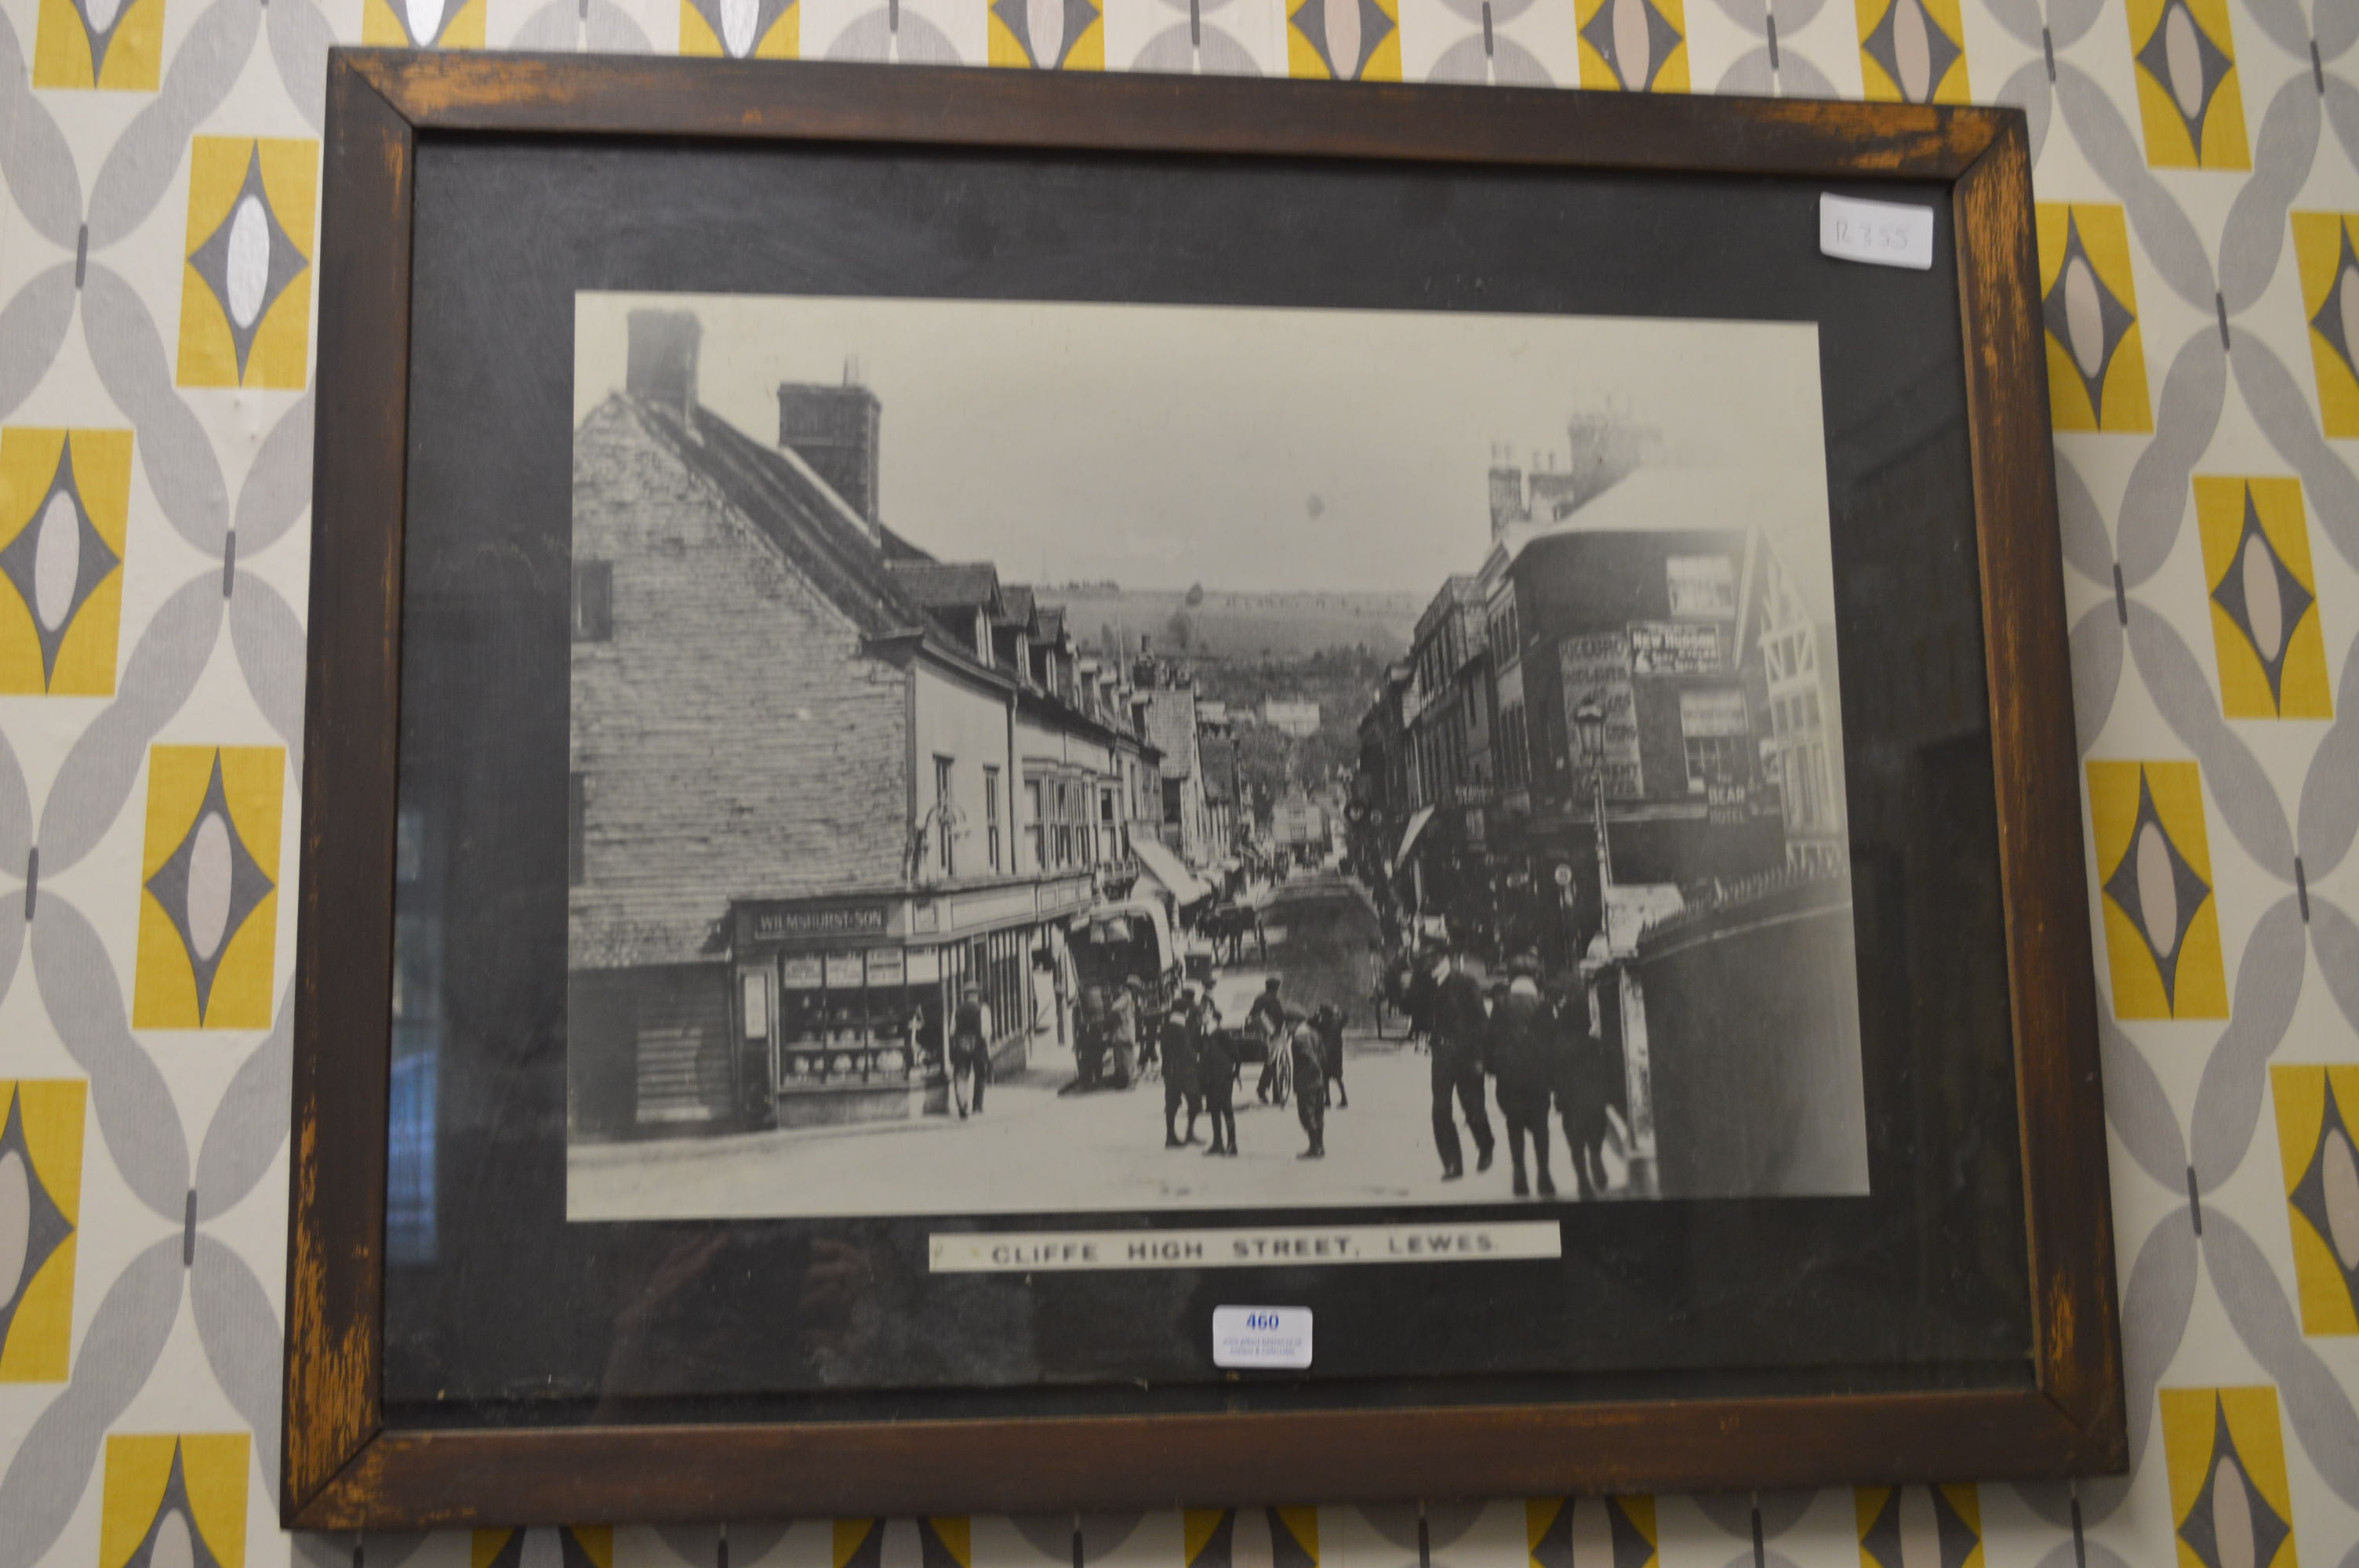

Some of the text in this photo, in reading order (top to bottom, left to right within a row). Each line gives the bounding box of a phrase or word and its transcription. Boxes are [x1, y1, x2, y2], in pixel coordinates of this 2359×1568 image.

[1708, 784, 1746, 805] BEAR
[1709, 807, 1747, 825] HOTEL
[990, 1243, 1098, 1265] CLIFFE
[1127, 1240, 1204, 1261] HIGH
[1232, 1236, 1360, 1259] STREET,
[1245, 1310, 1280, 1330] 460
